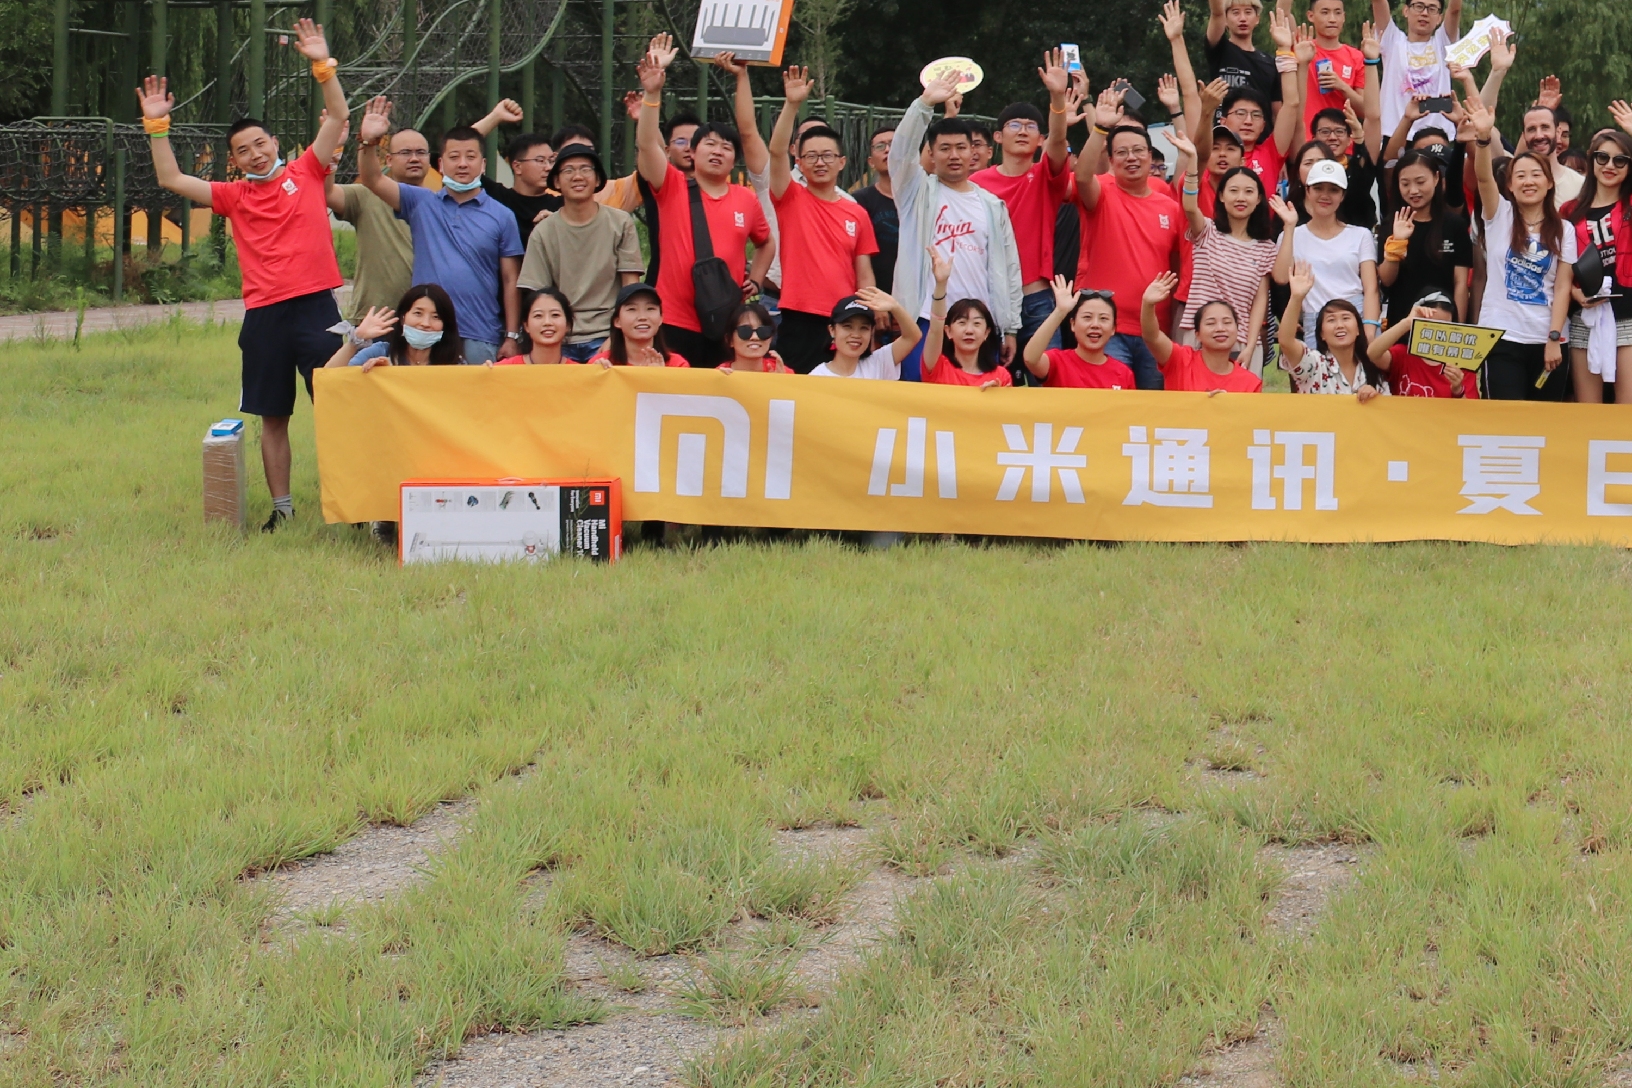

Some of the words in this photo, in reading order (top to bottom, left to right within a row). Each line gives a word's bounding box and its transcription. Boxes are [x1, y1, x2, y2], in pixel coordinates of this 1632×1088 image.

[1510, 256, 1544, 274] adidas
[1421, 328, 1477, 345] 何以解忧
[1417, 342, 1474, 360] 唯有暴富
[598, 519, 607, 530] Mi
[576, 519, 584, 549] Cleaner
[583, 519, 591, 550] Vacuum
[591, 519, 599, 556] Handheld
